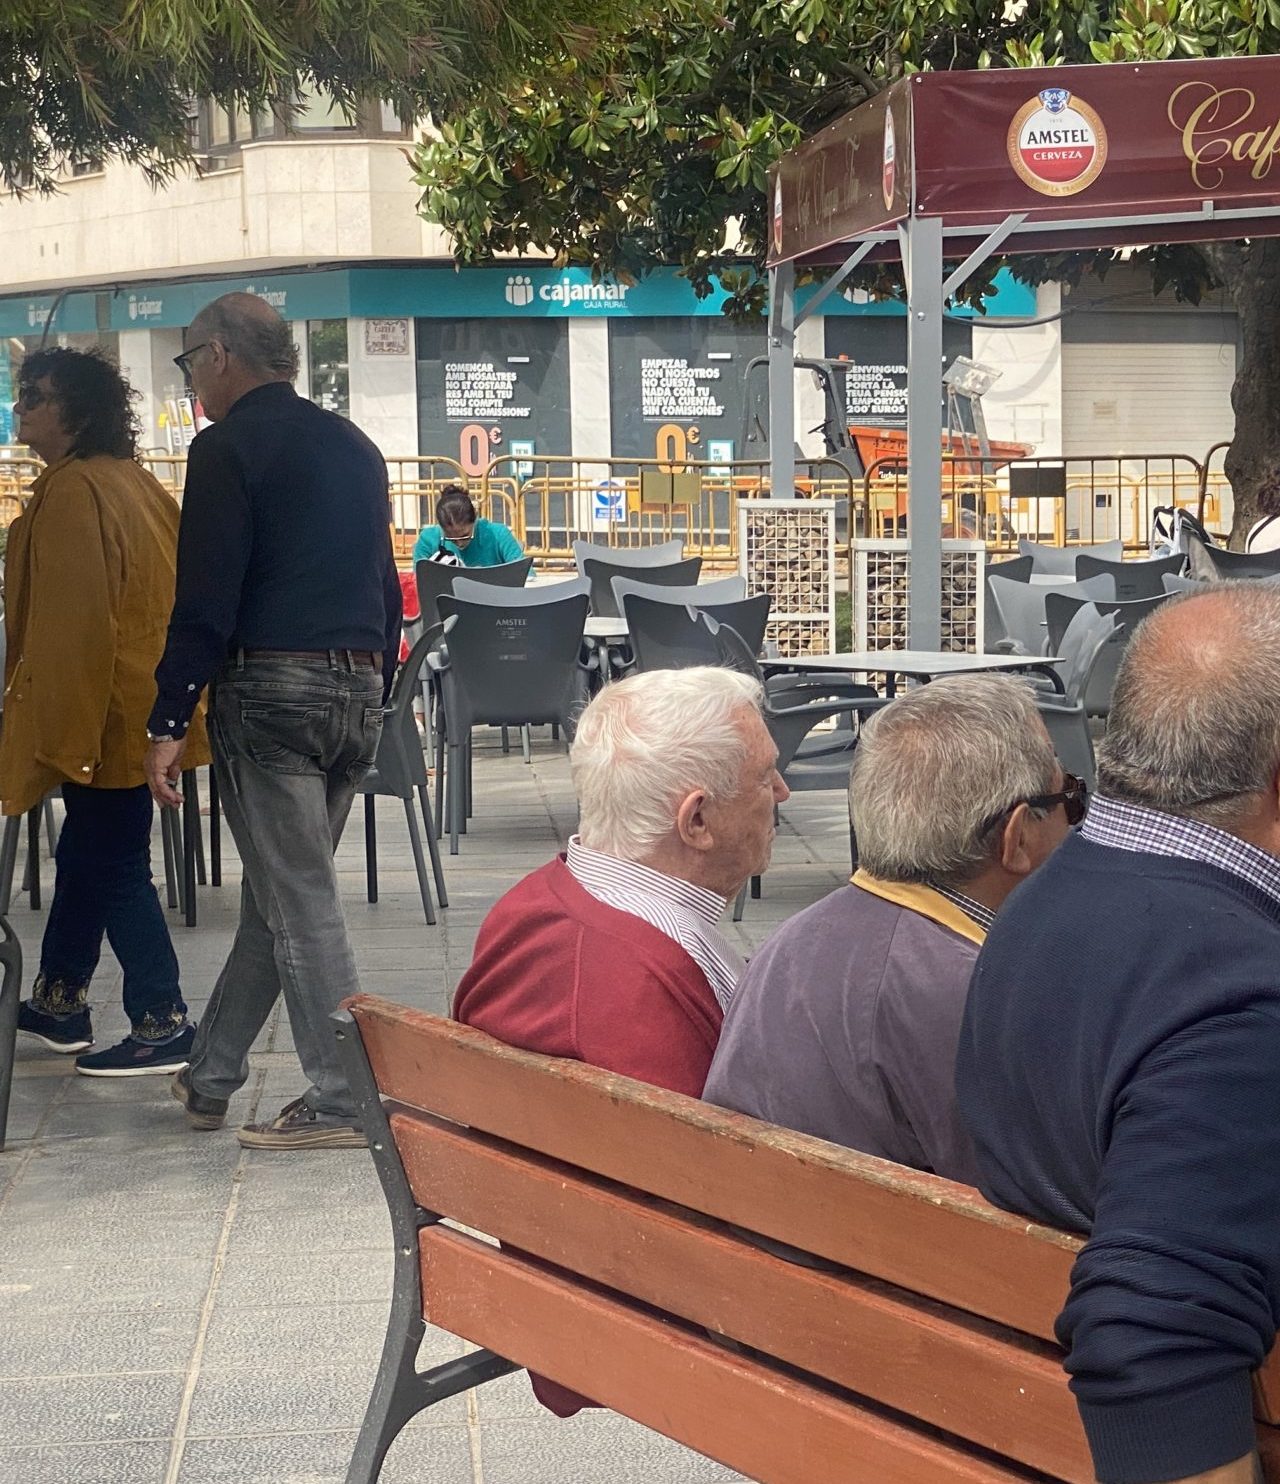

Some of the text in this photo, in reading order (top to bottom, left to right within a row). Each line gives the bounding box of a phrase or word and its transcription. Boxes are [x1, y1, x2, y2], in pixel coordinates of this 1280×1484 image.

[1027, 129, 1088, 145] AMSTEL
[1033, 151, 1082, 160] CERVEZA
[540, 278, 629, 307] cajamar
[584, 301, 628, 309] CAJA RURAL
[445, 363, 494, 373] COMENÇAR
[641, 359, 688, 369] EMPEZAR
[641, 368, 720, 378] CON NOSOTROS
[847, 365, 908, 374] ENVINGUD
[445, 372, 517, 381] AMB NOSALTRES
[445, 381, 460, 390] NO
[462, 381, 472, 390] ET
[642, 378, 696, 387] NO CUESTA
[845, 381, 895, 389] PORTA LA
[445, 390, 513, 399] RES AMB EL TEU
[642, 387, 710, 397] NADA CON TU
[846, 389, 872, 397] TEUA
[446, 399, 503, 407] NOU COMPTE
[642, 396, 716, 406] NUEVA CUENTA
[846, 397, 850, 405] I
[446, 407, 473, 416] SENSE
[642, 406, 660, 415] SIN
[871, 405, 905, 413] EUROS
